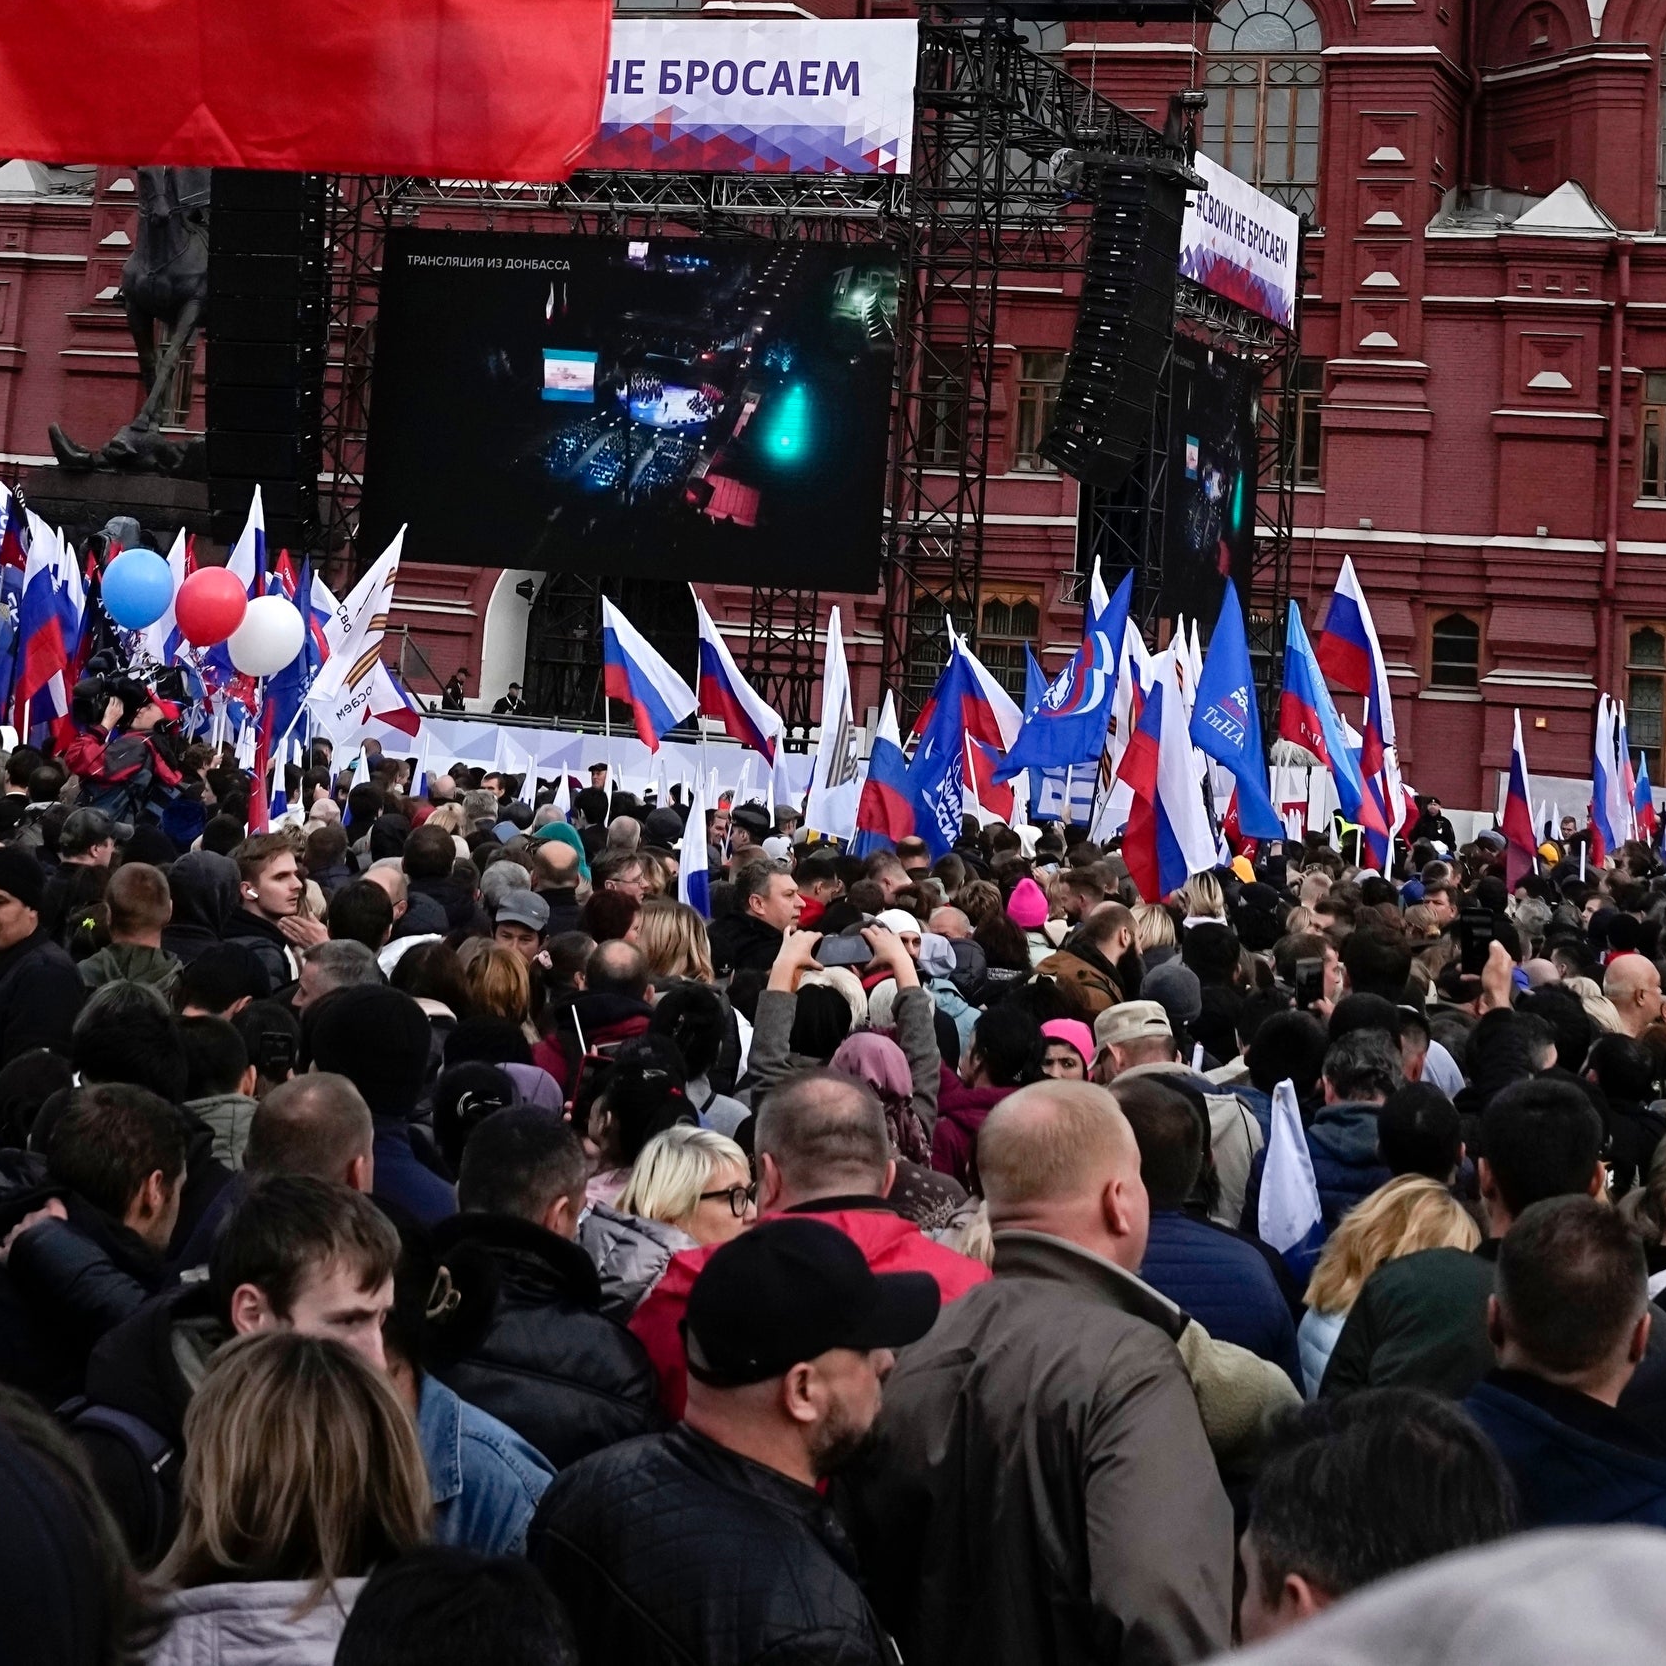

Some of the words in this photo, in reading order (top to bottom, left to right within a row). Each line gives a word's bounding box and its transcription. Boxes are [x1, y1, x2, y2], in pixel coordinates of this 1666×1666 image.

[658, 60, 860, 97] БРОСАЕМ
[1196, 190, 1233, 236] #СВОИХ
[1235, 210, 1247, 244] НЕ
[1247, 219, 1288, 268] БРОСАЕМ
[407, 254, 484, 269] ТРАНСЛЯЦИЯ
[487, 258, 503, 269] ИЗ
[505, 258, 571, 271] ДОНБАССА
[1201, 706, 1245, 751] ТиНА
